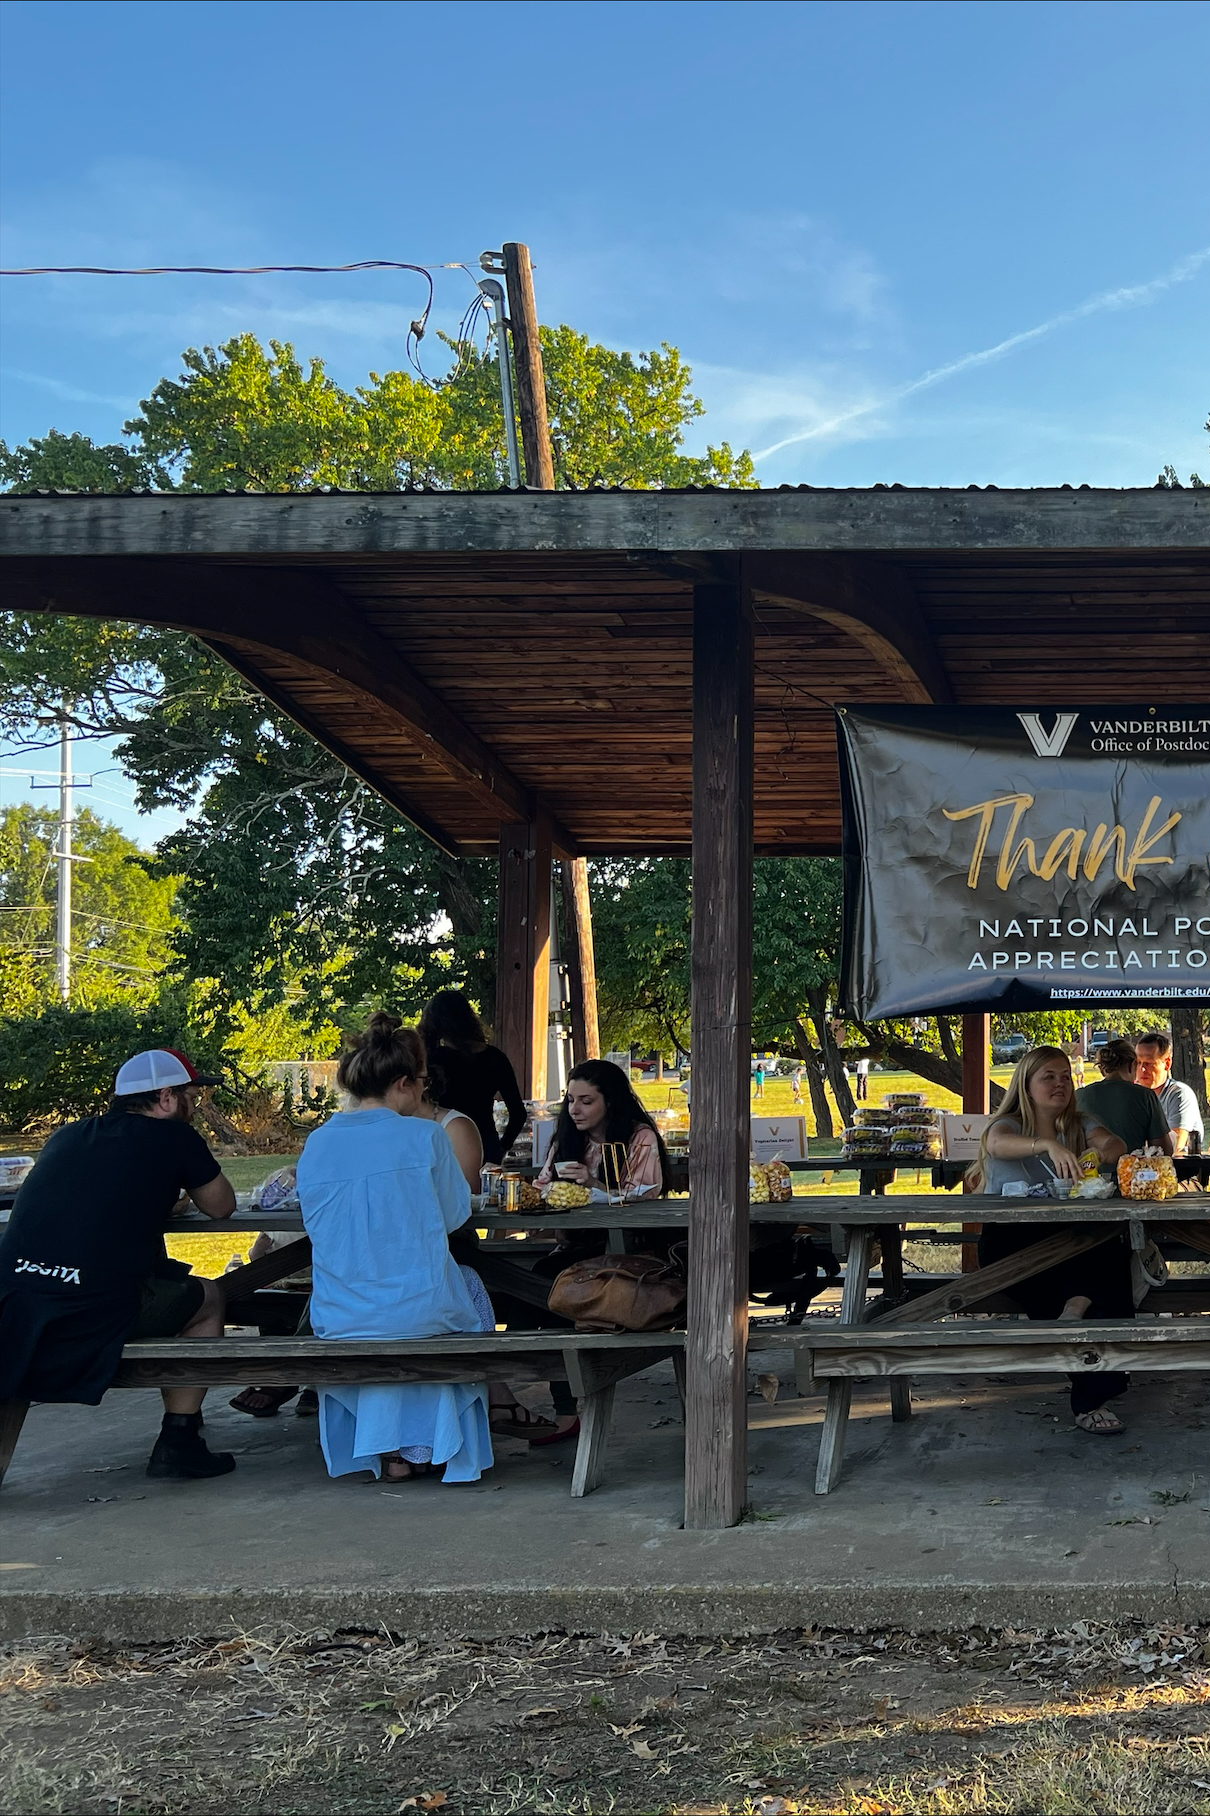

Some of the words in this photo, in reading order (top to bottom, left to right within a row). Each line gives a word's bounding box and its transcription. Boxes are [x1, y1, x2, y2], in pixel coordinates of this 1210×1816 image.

[1090, 719, 1210, 734] VANDERBILT
[1090, 736, 1134, 753] Office
[1136, 736, 1152, 752] of
[941, 792, 1183, 893] Thank
[978, 916, 1159, 939] NATIONAL
